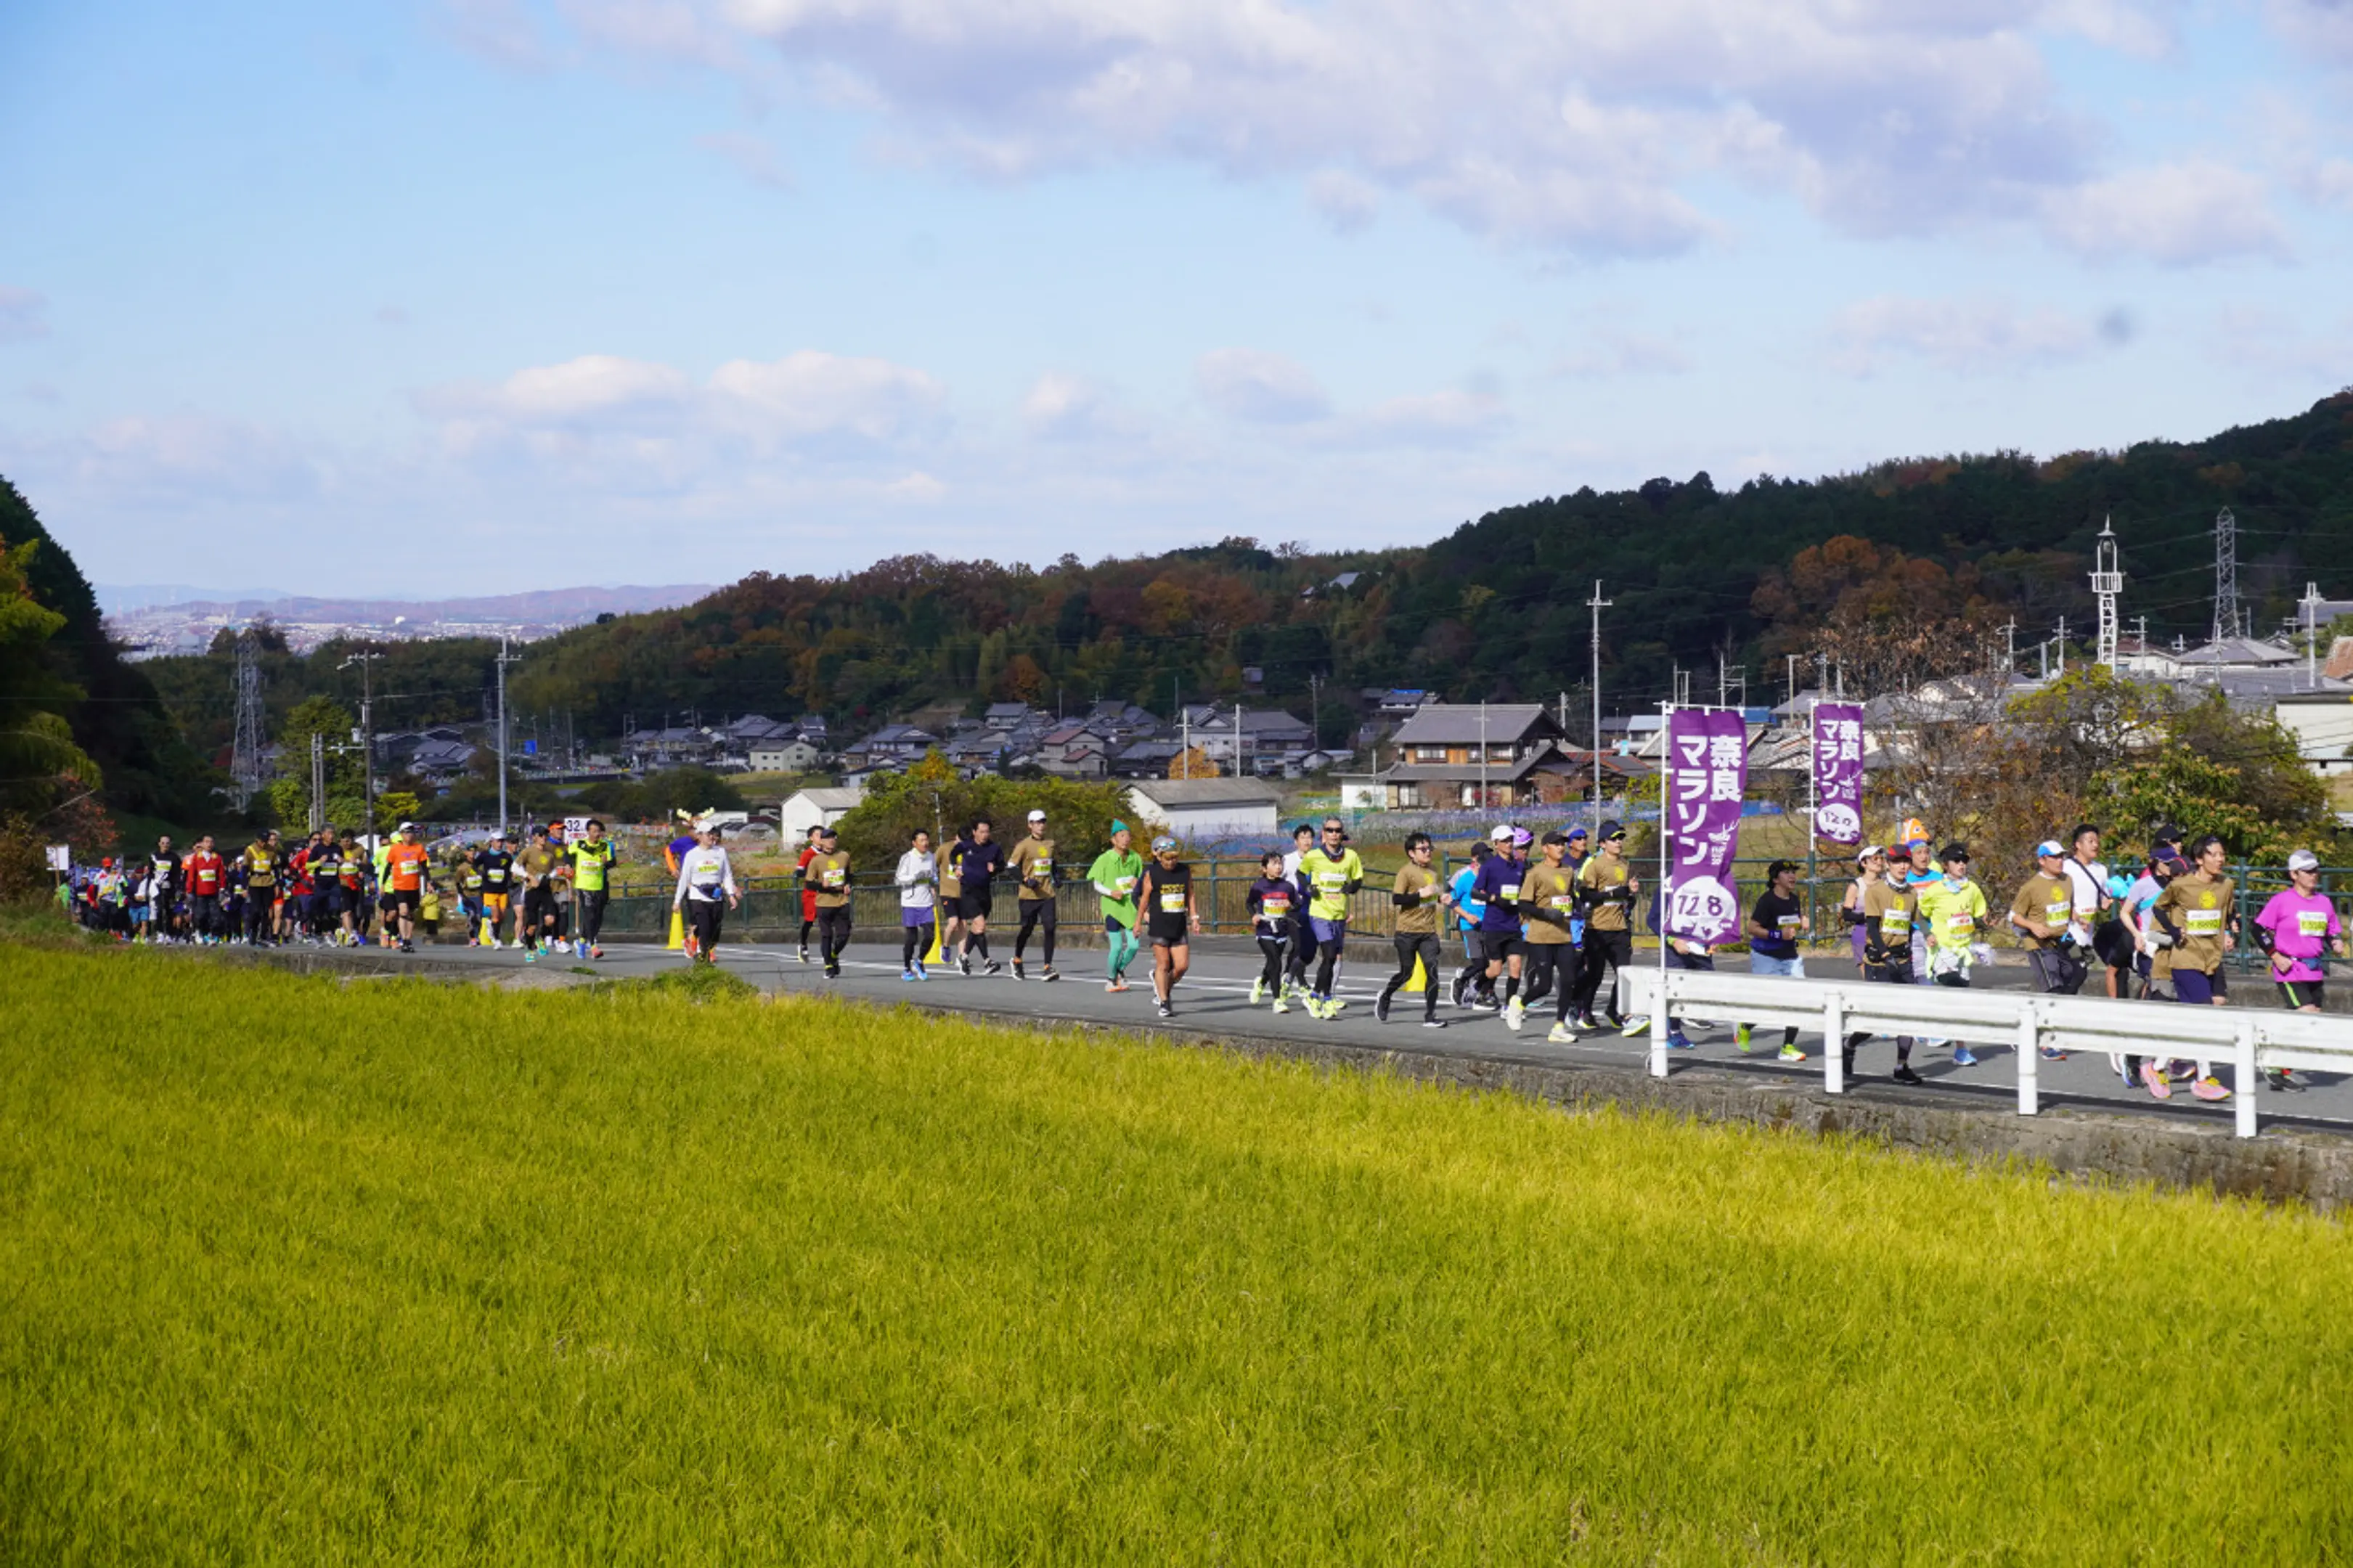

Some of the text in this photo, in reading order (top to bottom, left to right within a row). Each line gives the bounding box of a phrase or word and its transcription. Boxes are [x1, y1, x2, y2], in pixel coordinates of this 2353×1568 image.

[1710, 735, 1742, 802] 奈良
[1819, 719, 1838, 799] マラソン
[1840, 719, 1860, 761] 奈良
[1676, 735, 1708, 865] マラソン
